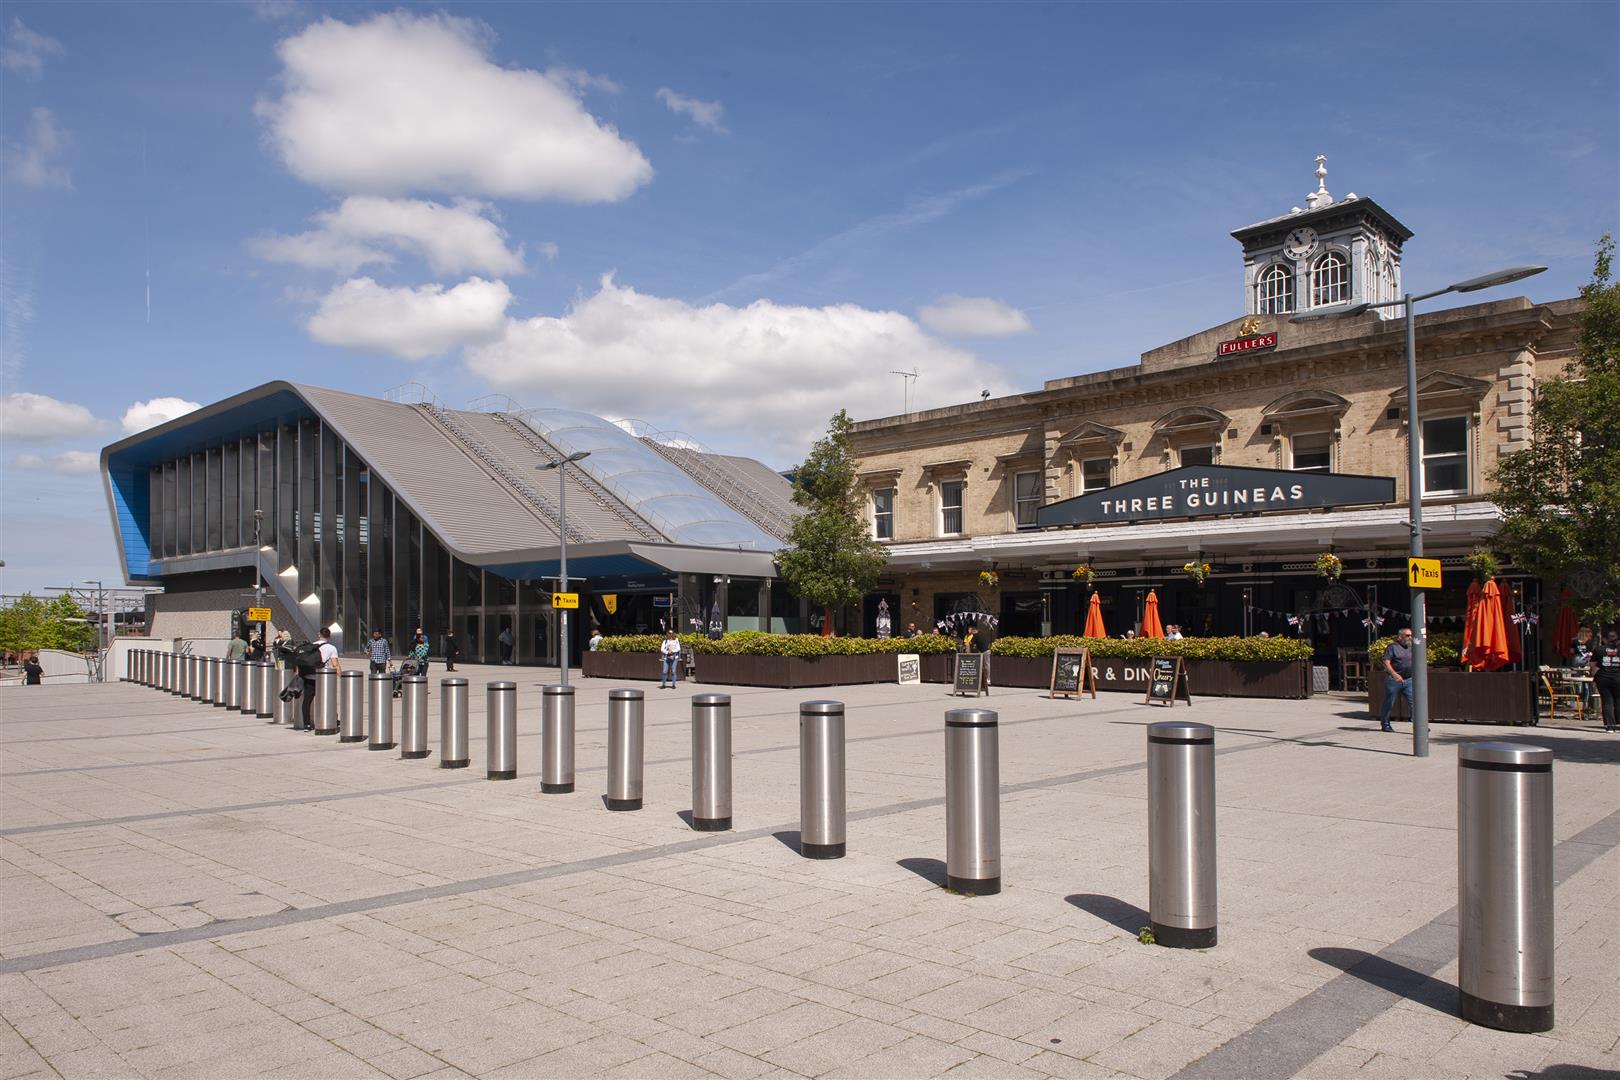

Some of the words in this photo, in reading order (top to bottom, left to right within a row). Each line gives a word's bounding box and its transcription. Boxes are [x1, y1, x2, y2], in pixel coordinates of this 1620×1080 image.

[1222, 336, 1273, 353] FULLER'S
[1179, 477, 1209, 489] THE
[1101, 495, 1174, 515] THREE
[1186, 484, 1304, 508] GUINEAS
[1421, 567, 1439, 578] Taxis
[1105, 666, 1118, 681] &
